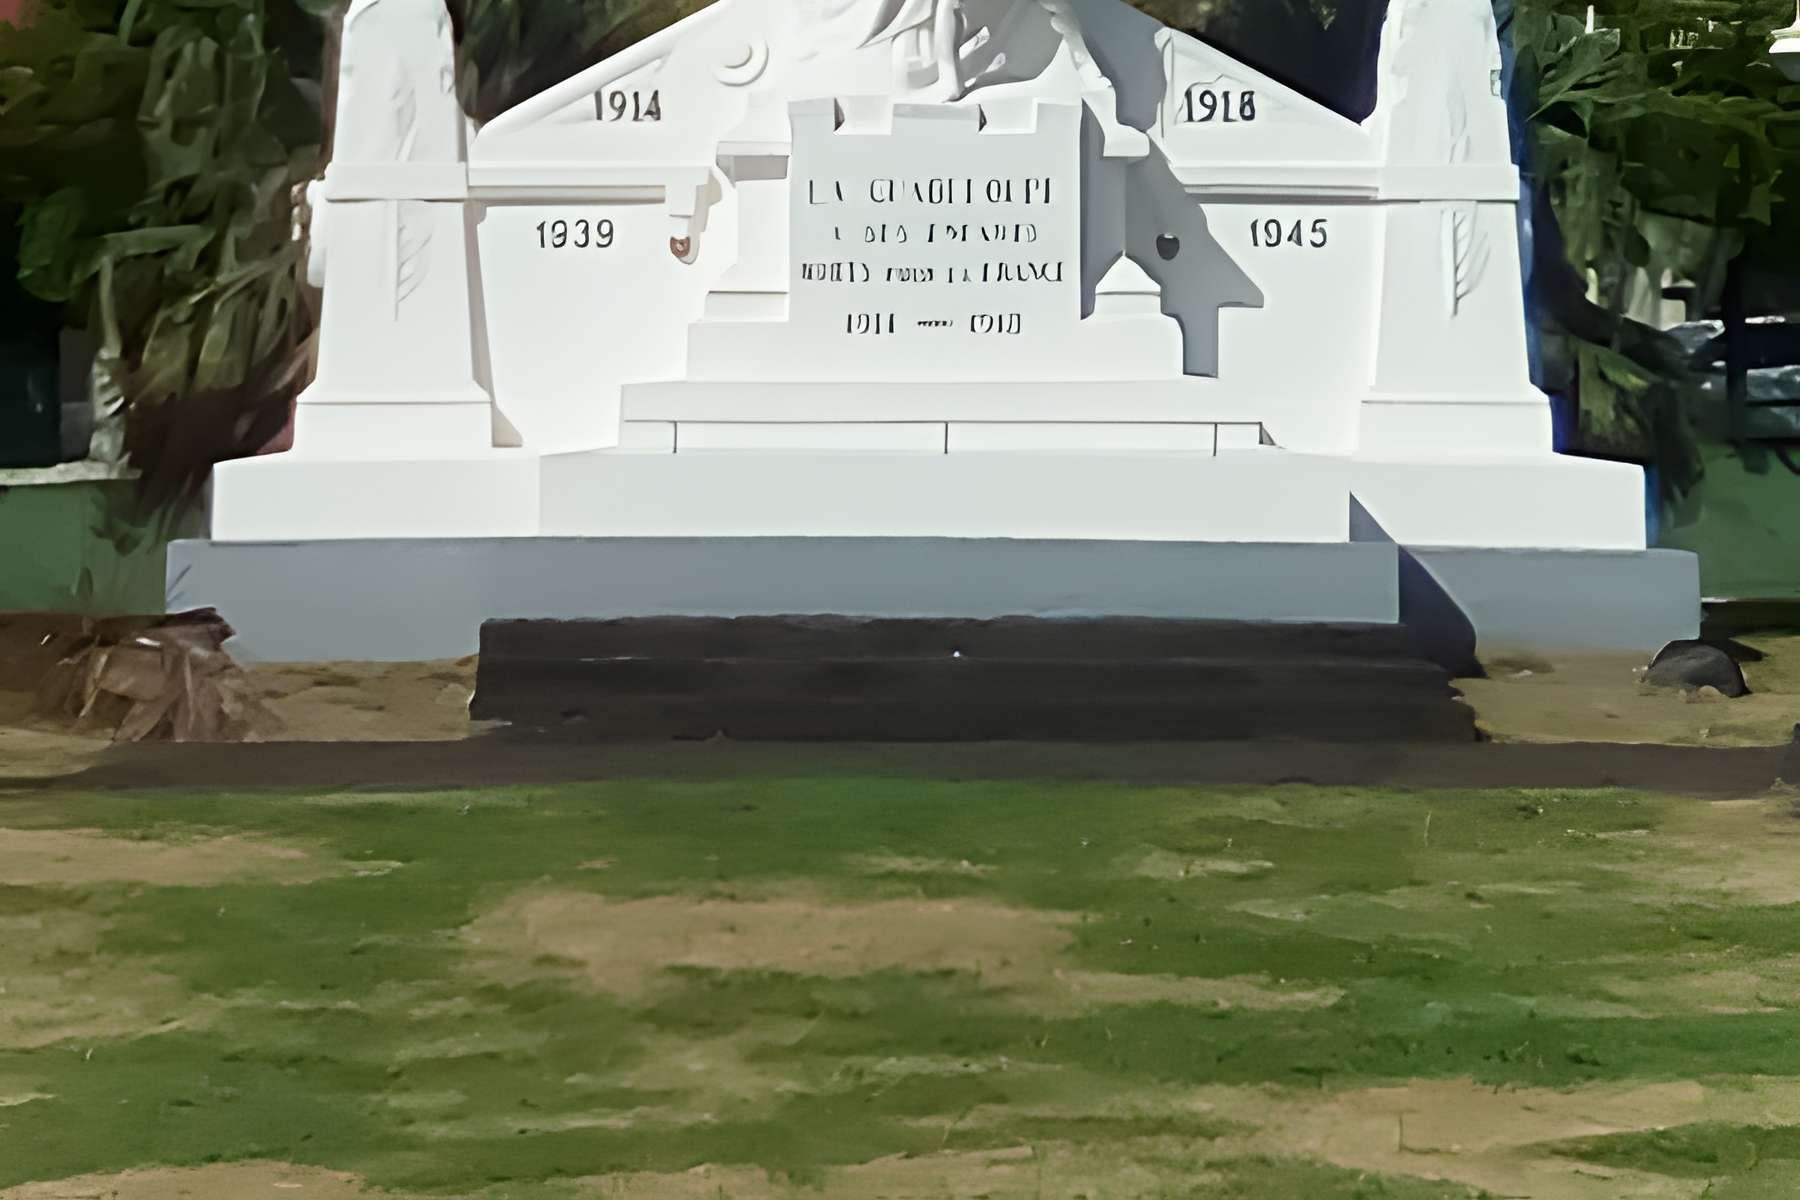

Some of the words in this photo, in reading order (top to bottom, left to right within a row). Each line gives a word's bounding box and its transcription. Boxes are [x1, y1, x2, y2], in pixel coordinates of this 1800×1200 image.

[594, 89, 661, 121] 1914
[1184, 89, 1256, 122] 1918
[536, 219, 614, 248] 1939
[1250, 218, 1327, 248] 1945
